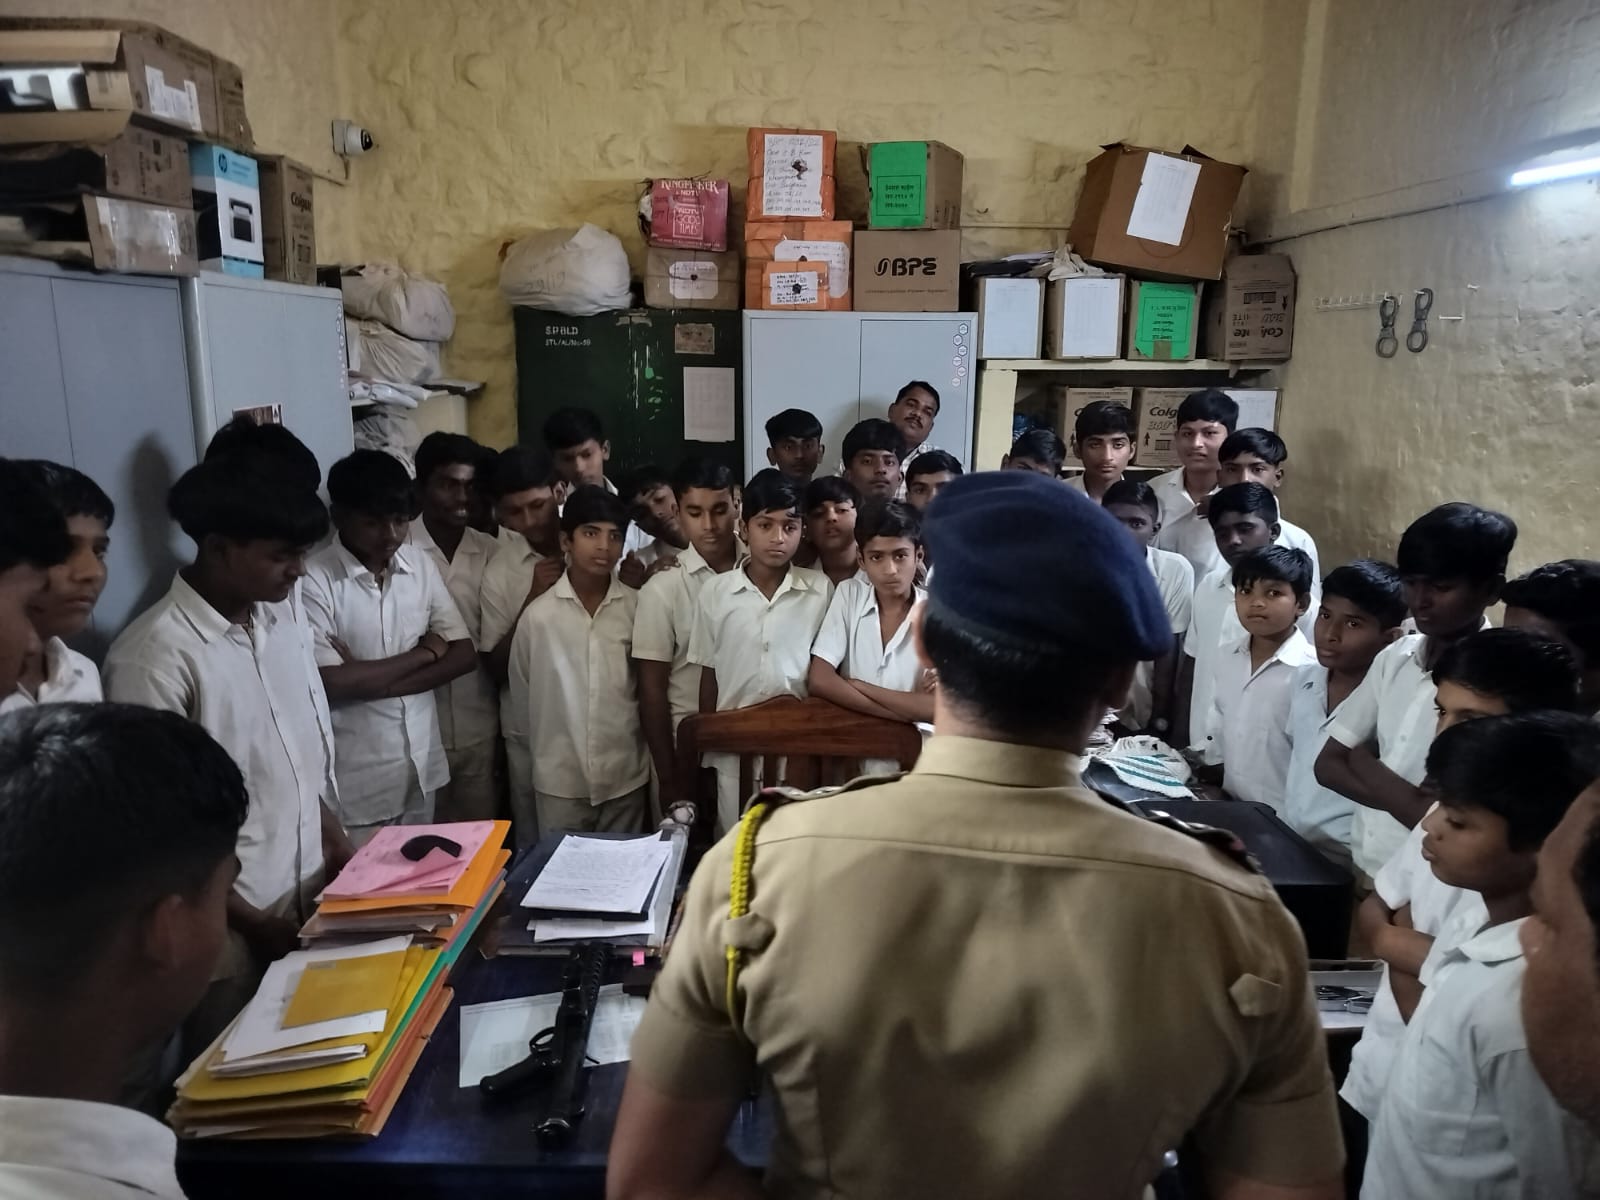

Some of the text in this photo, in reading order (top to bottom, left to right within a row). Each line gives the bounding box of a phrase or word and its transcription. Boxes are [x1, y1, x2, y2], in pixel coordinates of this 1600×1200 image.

[661, 180, 719, 194] KINGFIHER
[892, 257, 938, 276] BPE
[1231, 327, 1284, 339] Colte
[1149, 406, 1179, 419] Colg
